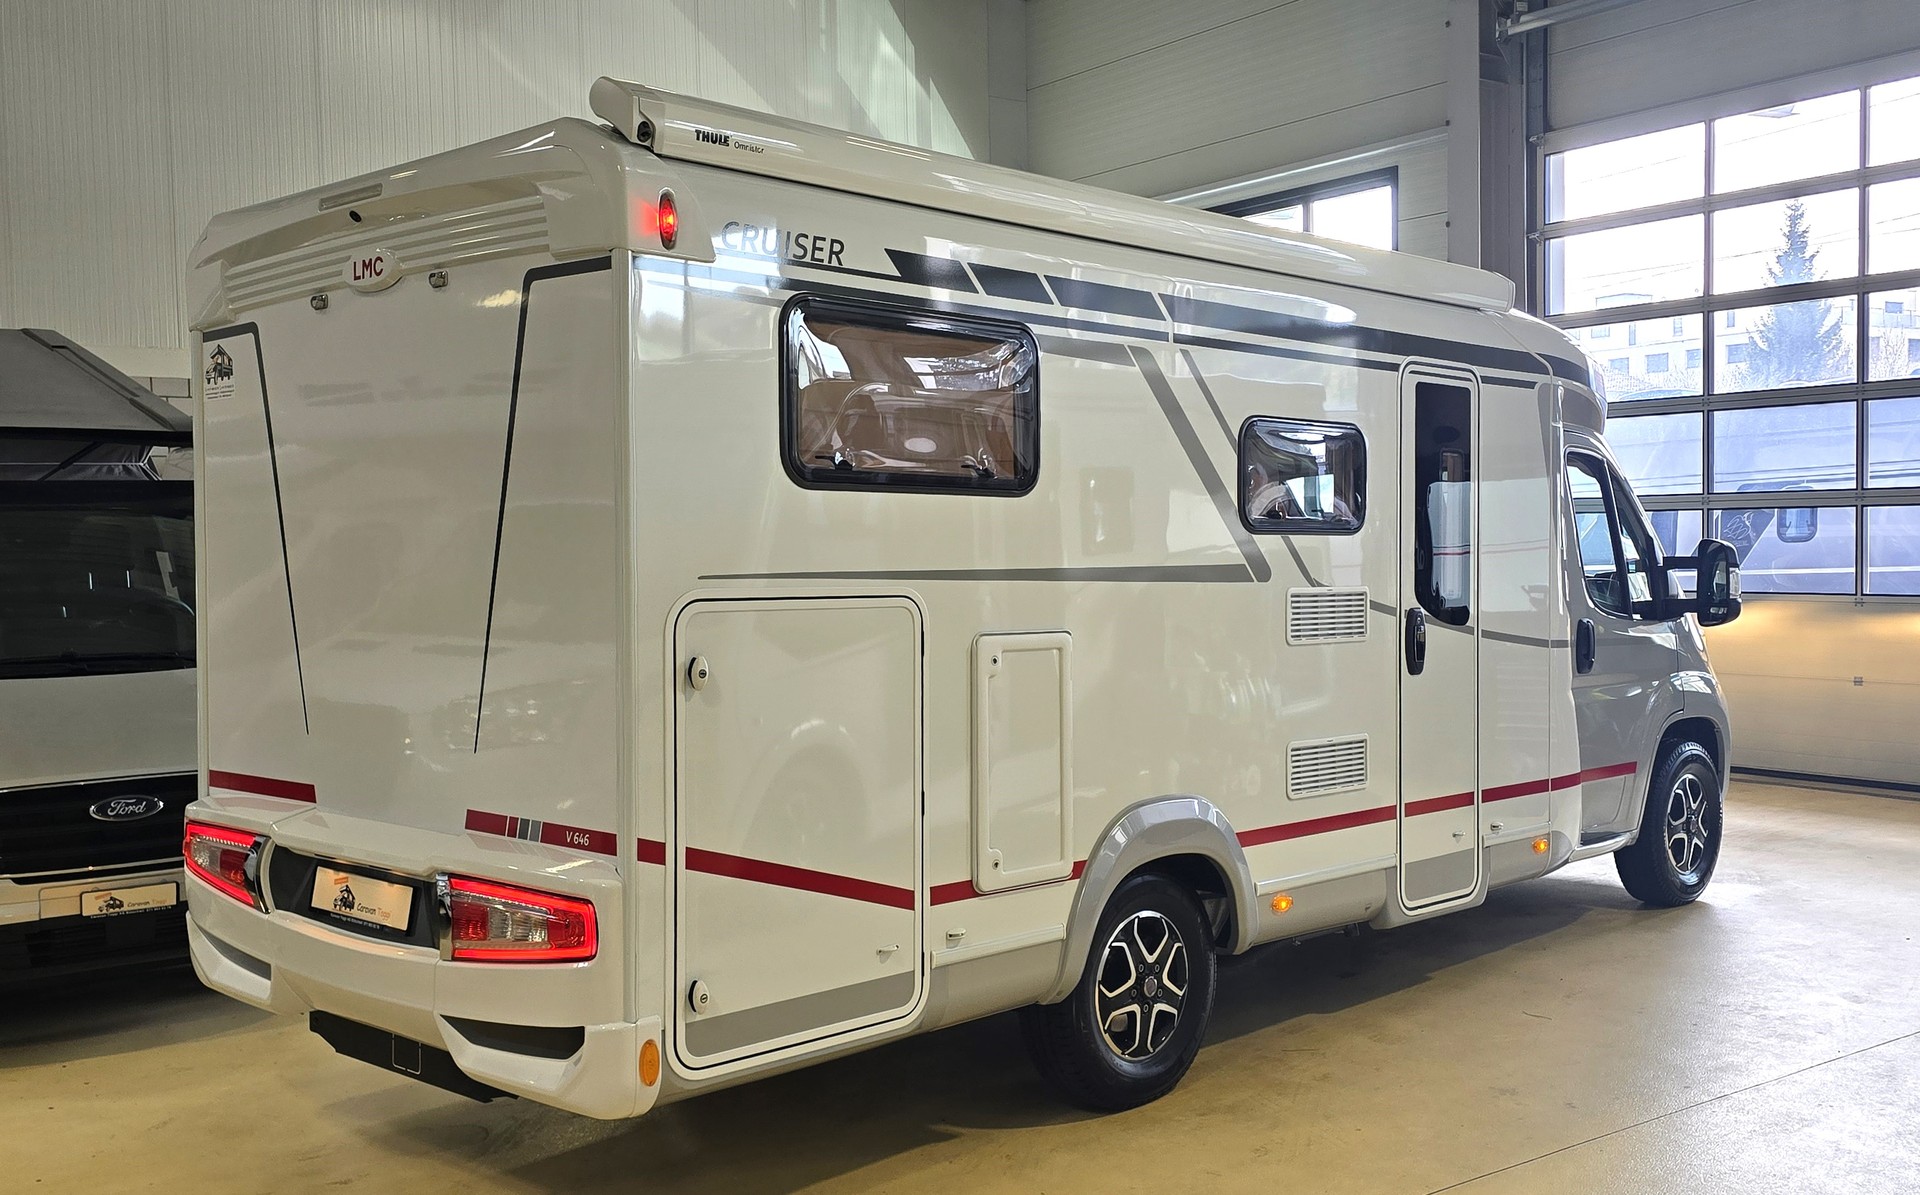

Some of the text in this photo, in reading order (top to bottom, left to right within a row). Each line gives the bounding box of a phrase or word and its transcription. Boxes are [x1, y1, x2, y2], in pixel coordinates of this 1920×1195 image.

[695, 129, 730, 147] THULE
[721, 220, 846, 267] CRUISER
[353, 256, 383, 280] LMC
[107, 798, 147, 816] Ford
[565, 831, 590, 845] V 646
[357, 903, 377, 915] Caravan
